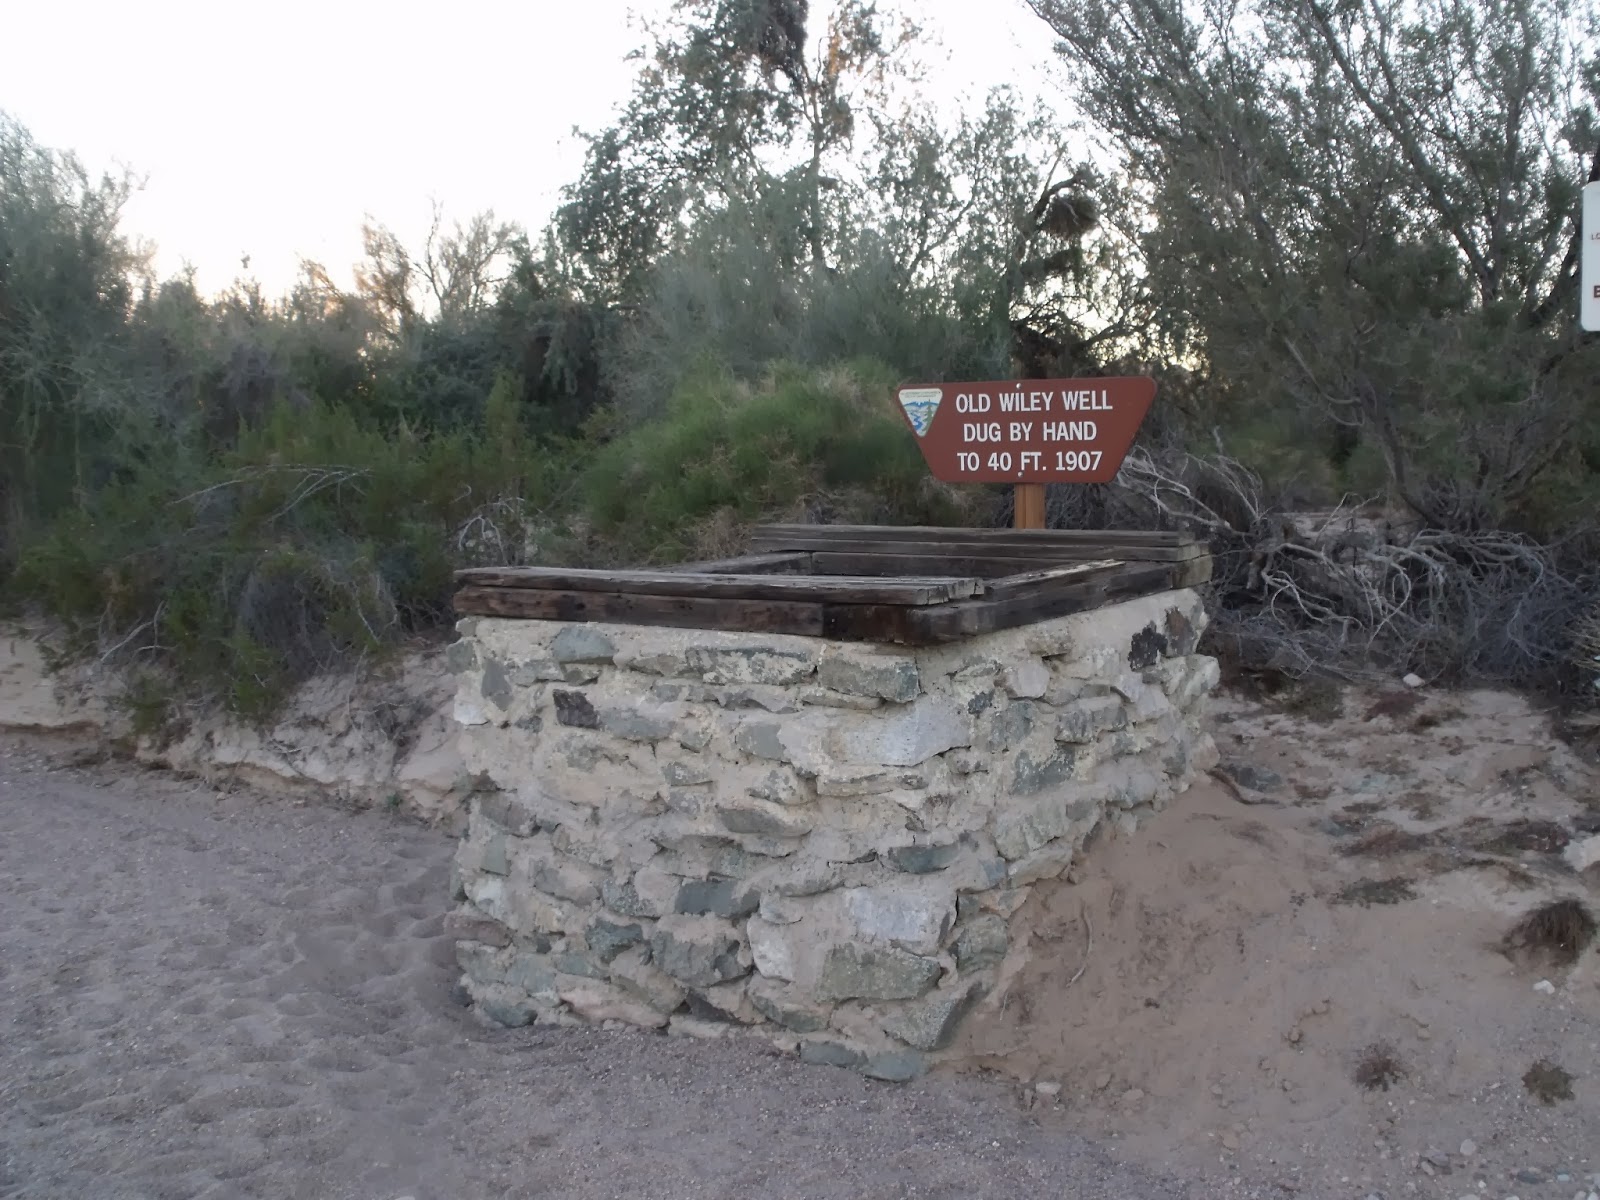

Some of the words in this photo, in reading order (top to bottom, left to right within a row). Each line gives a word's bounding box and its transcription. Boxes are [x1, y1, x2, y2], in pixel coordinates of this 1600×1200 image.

[955, 393, 991, 413] OLD
[999, 392, 1054, 412] WILEY
[1062, 390, 1113, 411] WELL
[963, 423, 1002, 443] DUG
[1009, 422, 1033, 442] BY
[1043, 421, 1097, 441] HAND
[957, 452, 980, 472] TO
[987, 452, 1012, 472] 40
[1020, 452, 1047, 471] FT.
[1055, 450, 1102, 471] 1907
